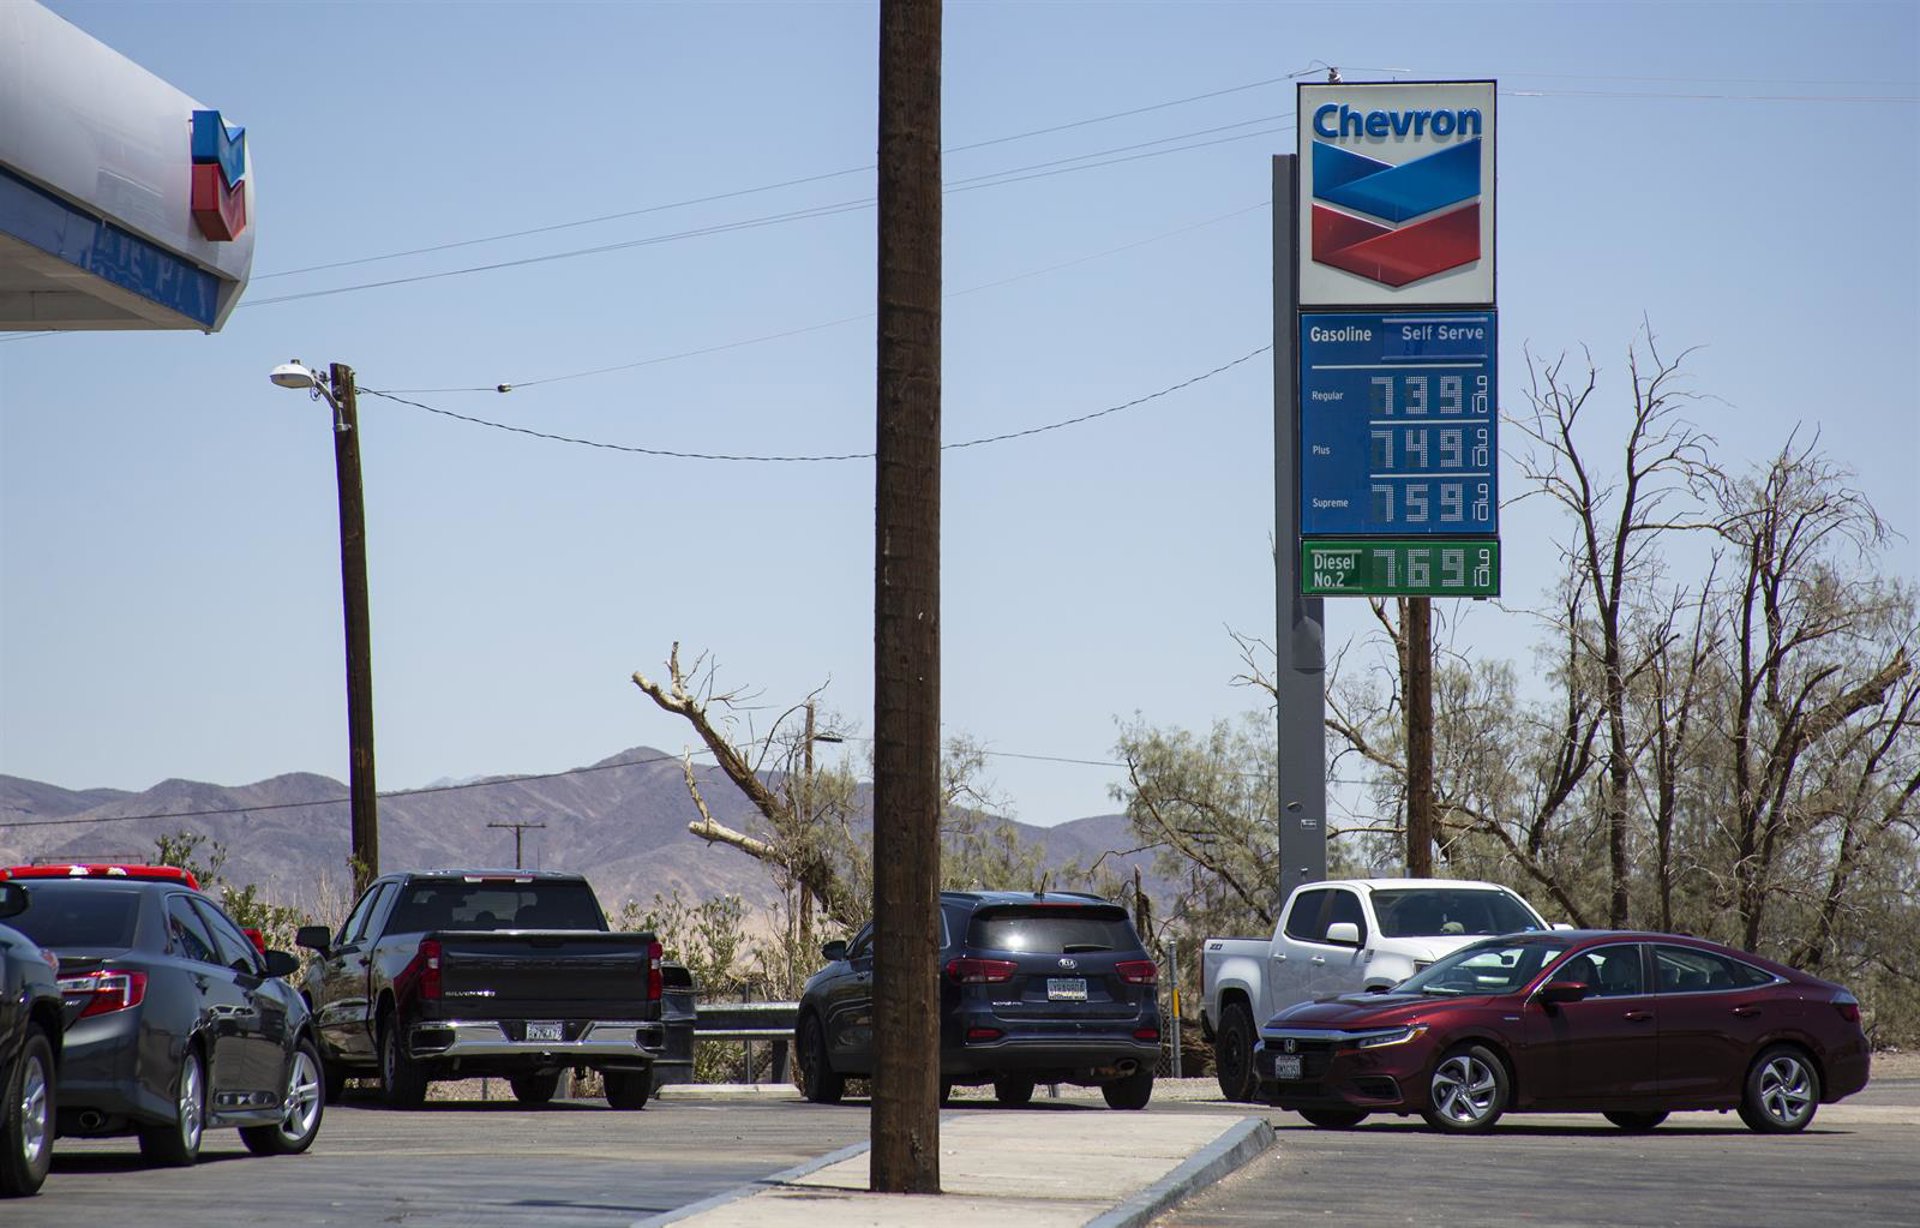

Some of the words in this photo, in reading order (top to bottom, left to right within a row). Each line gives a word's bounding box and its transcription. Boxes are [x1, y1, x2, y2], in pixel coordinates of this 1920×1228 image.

[1313, 102, 1482, 139] Chevron
[1310, 326, 1372, 342] Gasoline
[1402, 325, 1433, 341] Self
[1438, 325, 1484, 341] Serve
[1312, 391, 1344, 403] Regular
[1371, 376, 1463, 415] 739
[1312, 445, 1331, 455] Plus
[1371, 429, 1463, 468] 749
[1312, 498, 1349, 509] Supreme
[1371, 483, 1464, 522] 759
[1313, 554, 1355, 570] Diesel
[1373, 549, 1465, 588] 769
[1313, 572, 1345, 588] No.2
